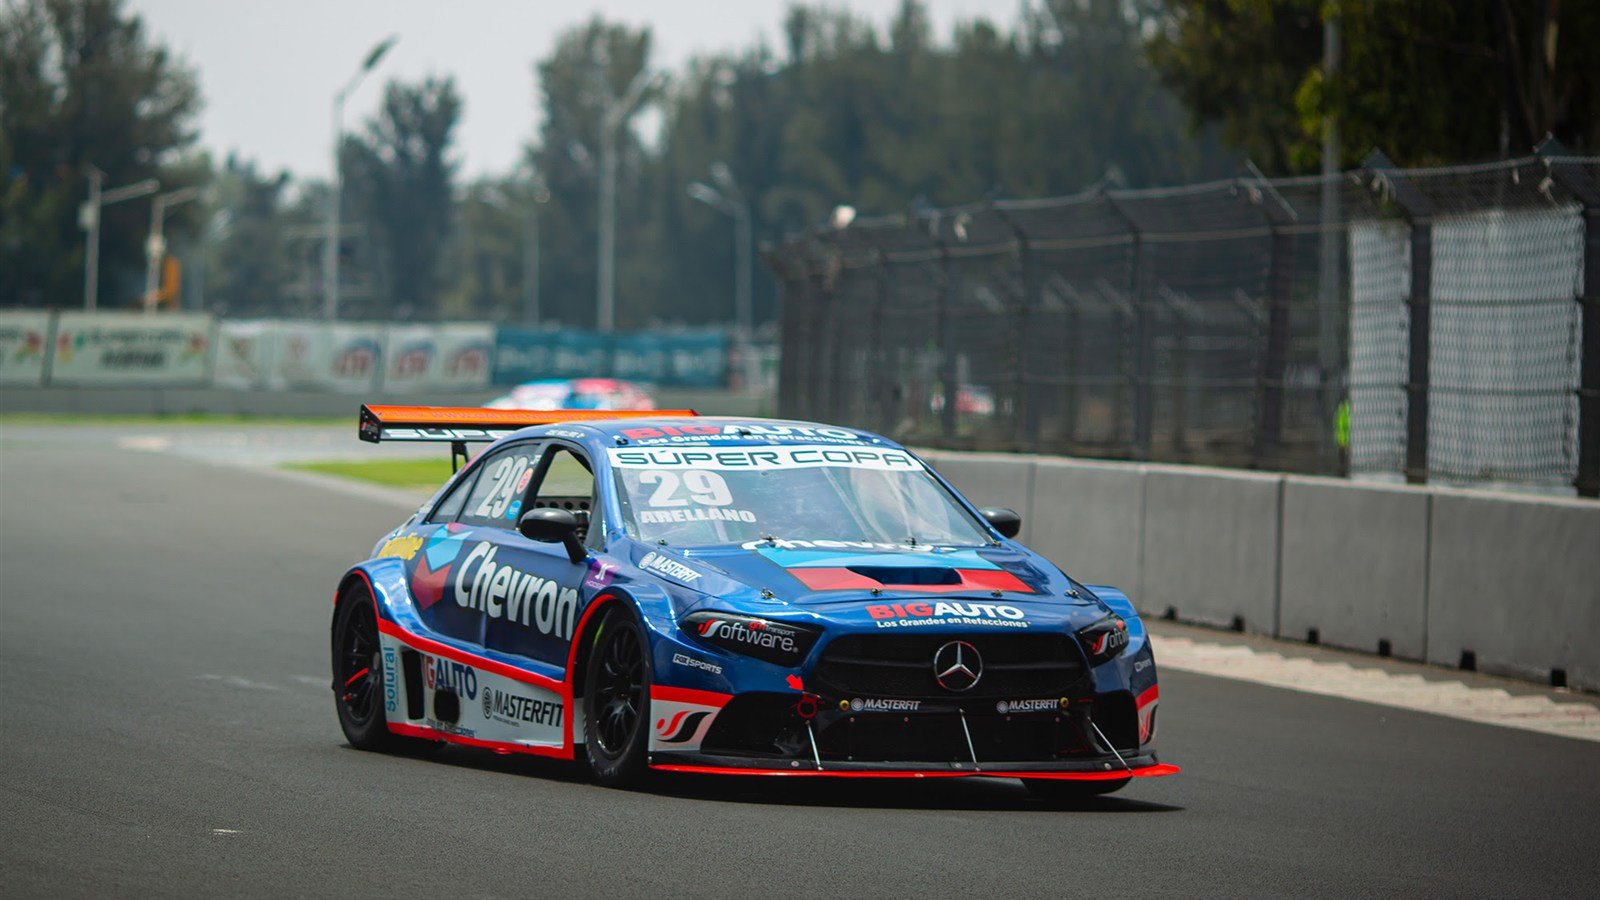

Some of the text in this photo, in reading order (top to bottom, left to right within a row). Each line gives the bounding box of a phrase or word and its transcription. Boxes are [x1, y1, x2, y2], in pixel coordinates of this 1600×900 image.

[619, 425, 858, 440] BIGAUTO
[637, 437, 669, 445] Los
[671, 433, 740, 443] Grandes
[789, 450, 913, 466] COPA
[476, 456, 529, 518] 29
[640, 469, 734, 507] 29
[640, 508, 757, 523] ARELLANO
[650, 555, 703, 583] MASTERFIT
[455, 541, 579, 641] Chevron
[865, 602, 1025, 620] BIGAUTO
[876, 617, 1028, 628] Los Grandes en Refacciones
[689, 659, 723, 675] SPORTS
[382, 647, 397, 713] solural
[494, 689, 564, 728] MASTERFIT
[864, 698, 921, 710] MASTERFIT
[1008, 698, 1060, 710] MASTERFIT
